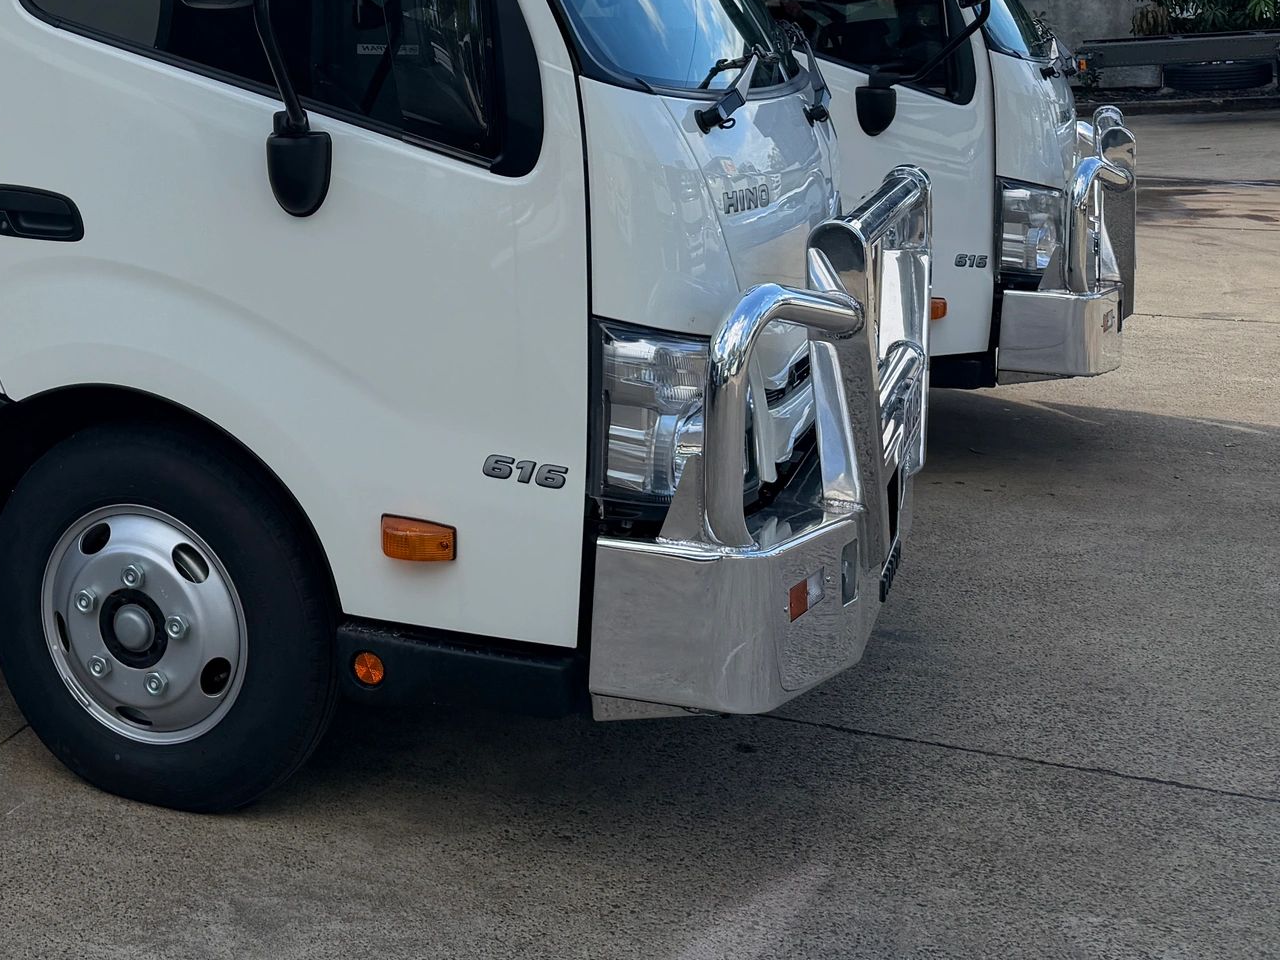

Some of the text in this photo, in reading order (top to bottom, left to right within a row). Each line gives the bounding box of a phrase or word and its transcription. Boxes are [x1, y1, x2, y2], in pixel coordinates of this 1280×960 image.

[723, 184, 770, 214] HINO
[954, 253, 988, 268] 616
[482, 454, 569, 489] 616
